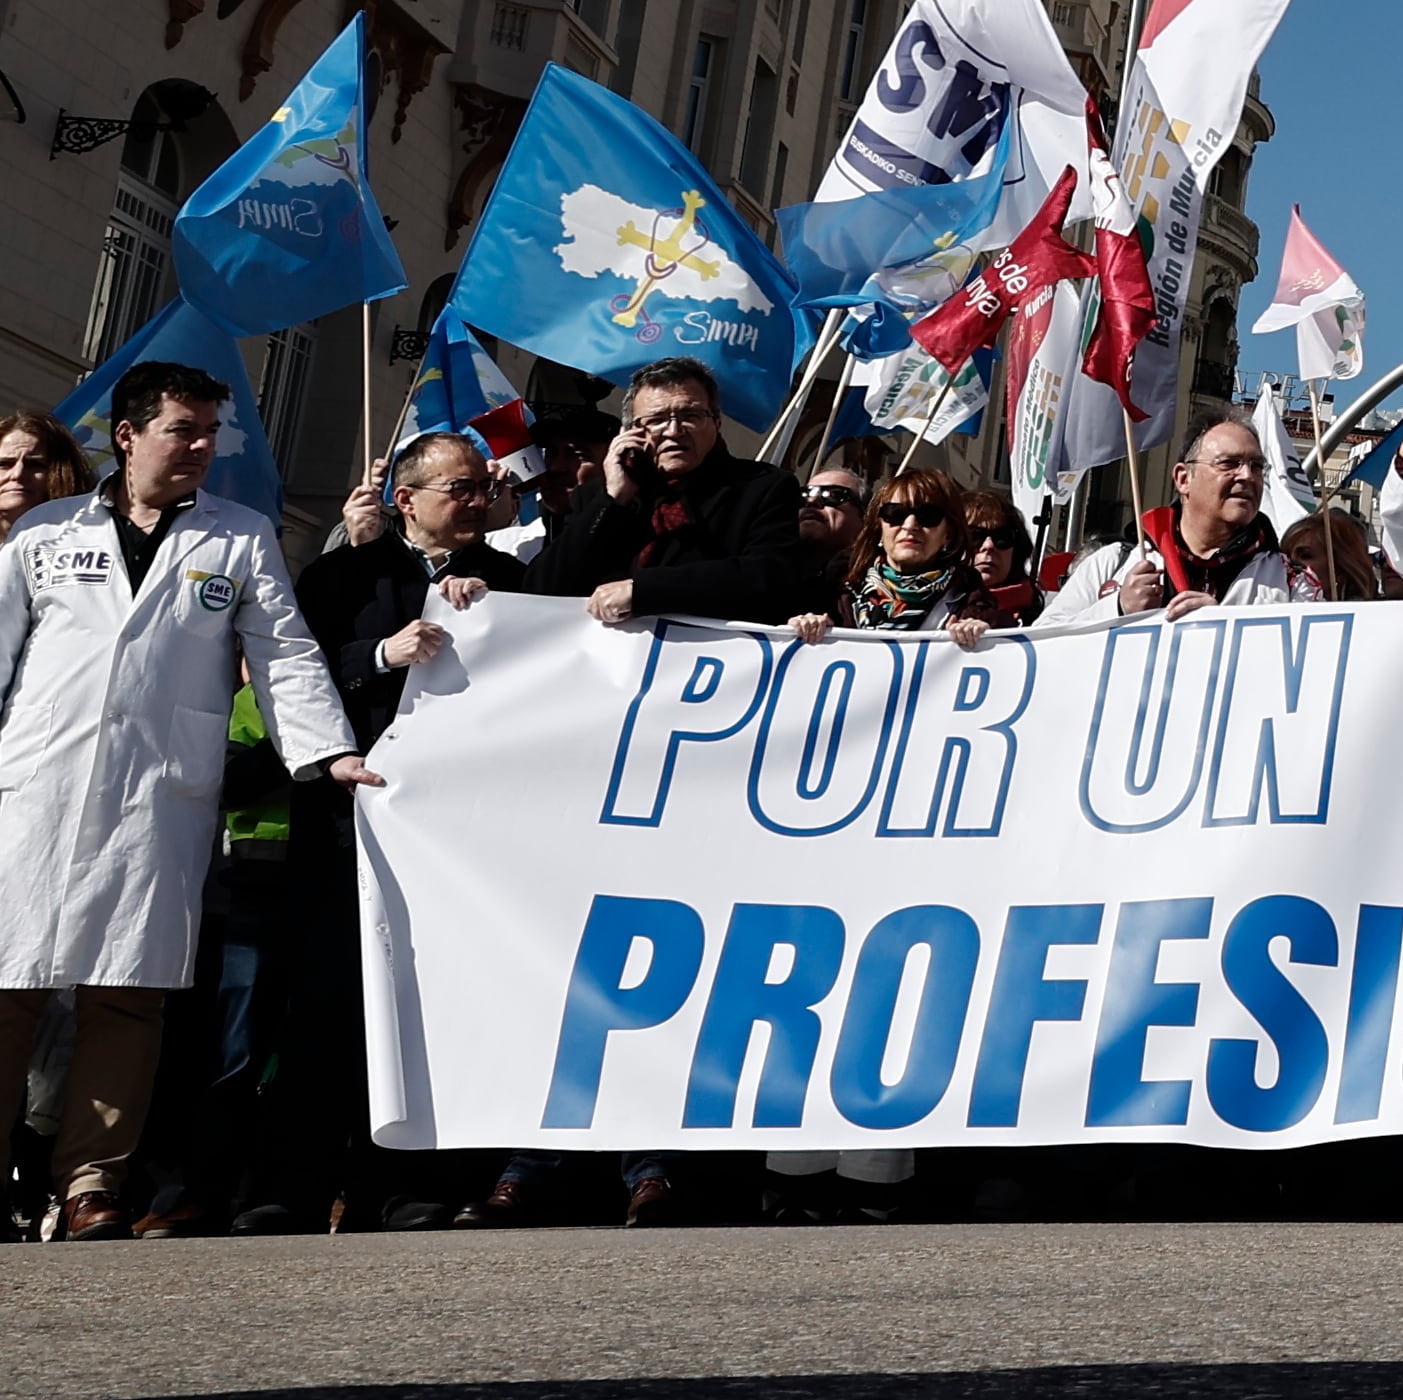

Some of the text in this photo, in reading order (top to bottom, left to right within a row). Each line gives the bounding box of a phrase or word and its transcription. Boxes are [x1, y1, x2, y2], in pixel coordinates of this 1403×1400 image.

[850, 135, 897, 174] EUSKADIKO
[1146, 126, 1223, 348] Región de Murcia
[54, 551, 111, 571] SME
[206, 582, 231, 597] SME
[599, 616, 1037, 839] POR
[1078, 614, 1354, 834] UN
